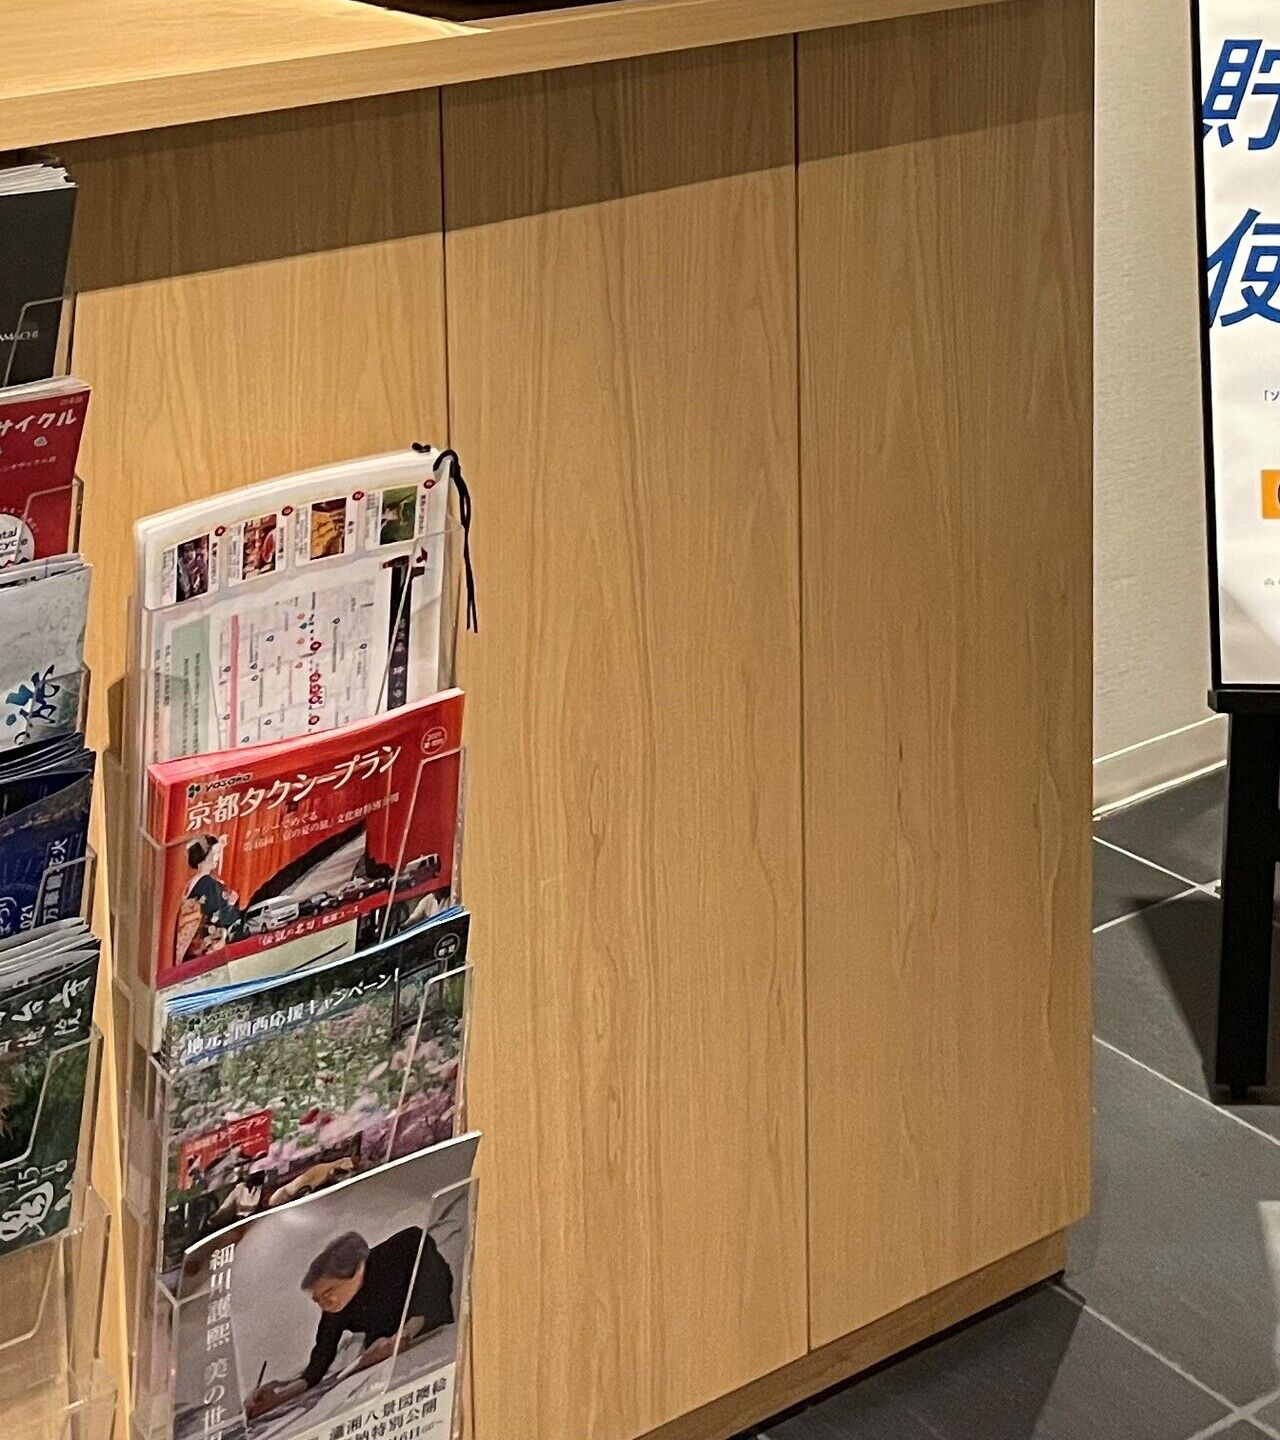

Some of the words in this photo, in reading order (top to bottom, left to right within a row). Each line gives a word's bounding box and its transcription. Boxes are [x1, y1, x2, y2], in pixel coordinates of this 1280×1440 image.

[185, 744, 403, 833] 京都タクシープラン
